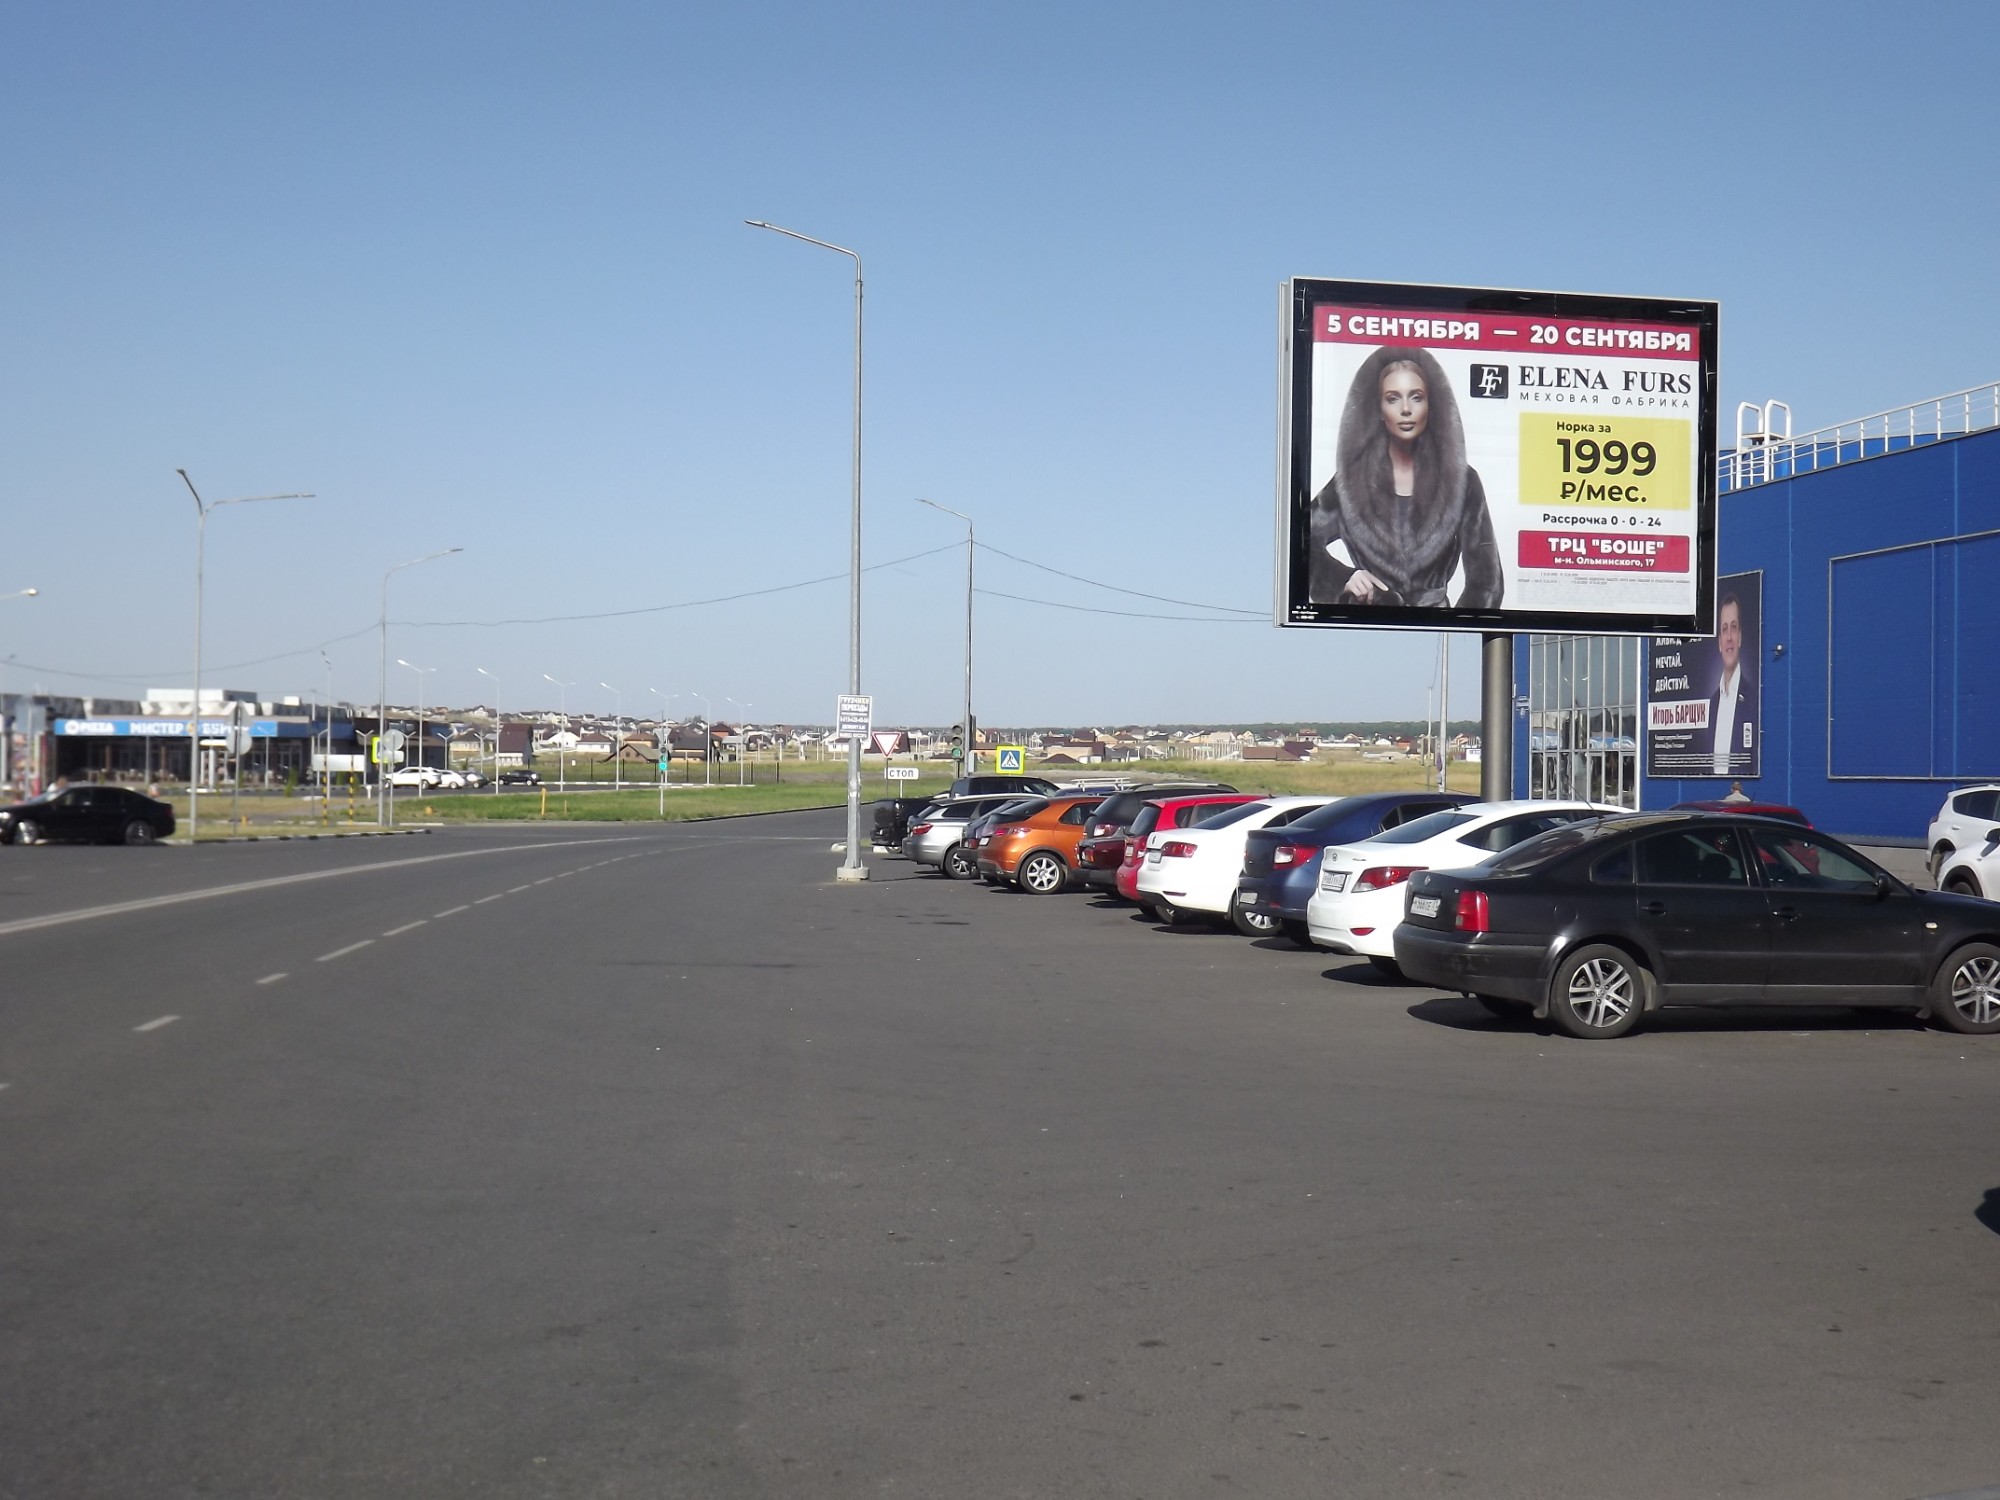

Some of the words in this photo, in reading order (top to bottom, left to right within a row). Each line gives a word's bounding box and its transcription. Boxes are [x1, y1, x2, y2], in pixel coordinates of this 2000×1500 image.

[1327, 314, 1342, 334] 5
[1348, 315, 1480, 341] СЕНТЯБРЯ
[1529, 325, 1559, 345] 20
[1565, 327, 1691, 352] СЕНТЯБРЯ
[1518, 365, 1609, 391] ELENA
[1622, 370, 1692, 395] FURS
[1520, 391, 1600, 405] МЕХОВАЯ
[1611, 395, 1690, 409] ФАБРИКА
[1556, 421, 1595, 434] Норка
[1598, 424, 1612, 433] за
[1556, 438, 1657, 477] 1999
[1542, 513, 1608, 527] Рассрочка
[1610, 516, 1618, 526] 0
[1629, 516, 1637, 526] 0
[1647, 517, 1662, 527] 24
[1547, 537, 1588, 556] ТРЦ
[1591, 538, 1665, 556] "БОШЕ"
[1554, 557, 1575, 565] м-н.
[1576, 557, 1644, 568] Ольминского,
[1645, 558, 1655, 567] 17
[1655, 651, 1683, 669] МЕЧТАЙ.
[1655, 674, 1690, 694] ДЕЙСТВУЙ.
[1652, 705, 1674, 727] Игорь
[1675, 702, 1706, 727] БАРЩУК
[130, 722, 184, 735] МИСТЕР
[889, 769, 914, 778] СТОП
